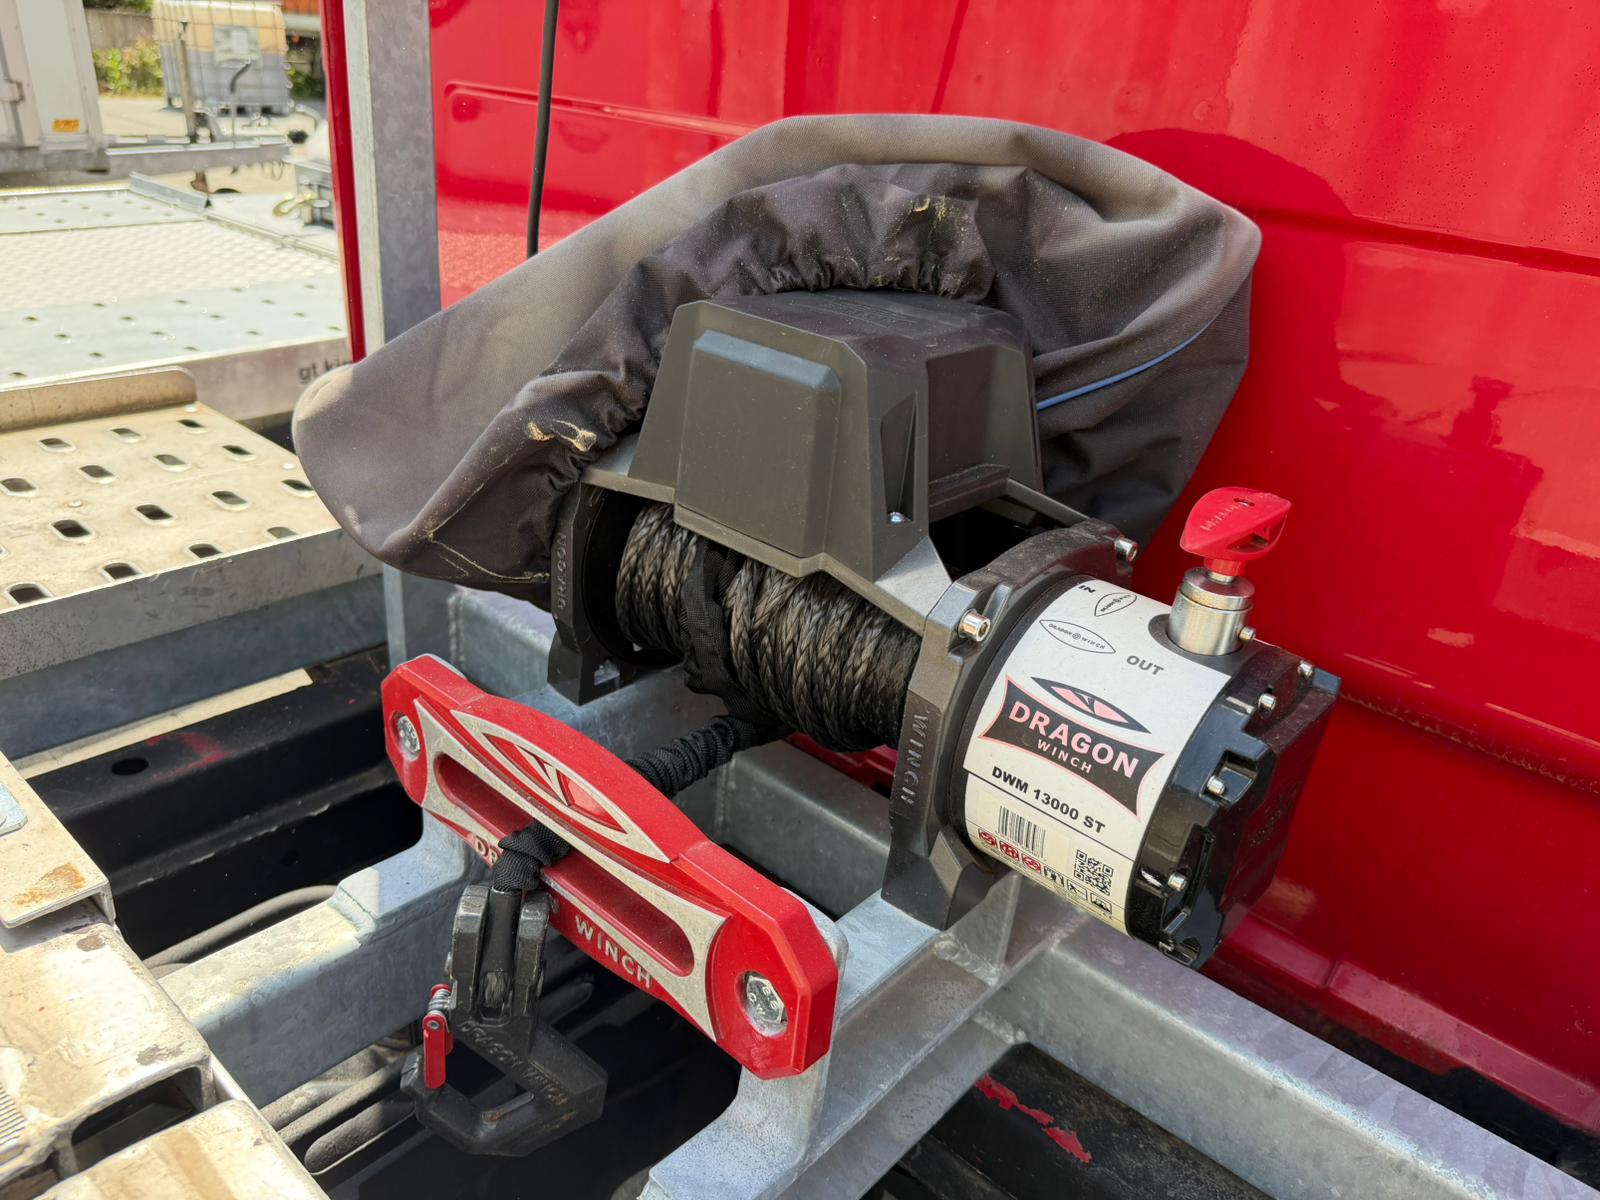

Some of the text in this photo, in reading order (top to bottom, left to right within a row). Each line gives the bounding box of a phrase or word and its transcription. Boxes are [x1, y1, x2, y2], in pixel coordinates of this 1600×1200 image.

[1078, 585, 1096, 594] IN
[1126, 655, 1165, 675] OUT
[900, 714, 929, 805] WINCH
[1008, 700, 1139, 779] DRAGON
[1037, 738, 1093, 774] WINCH
[991, 766, 1106, 834] DWM 13000 ST
[575, 915, 652, 989] WINCH
